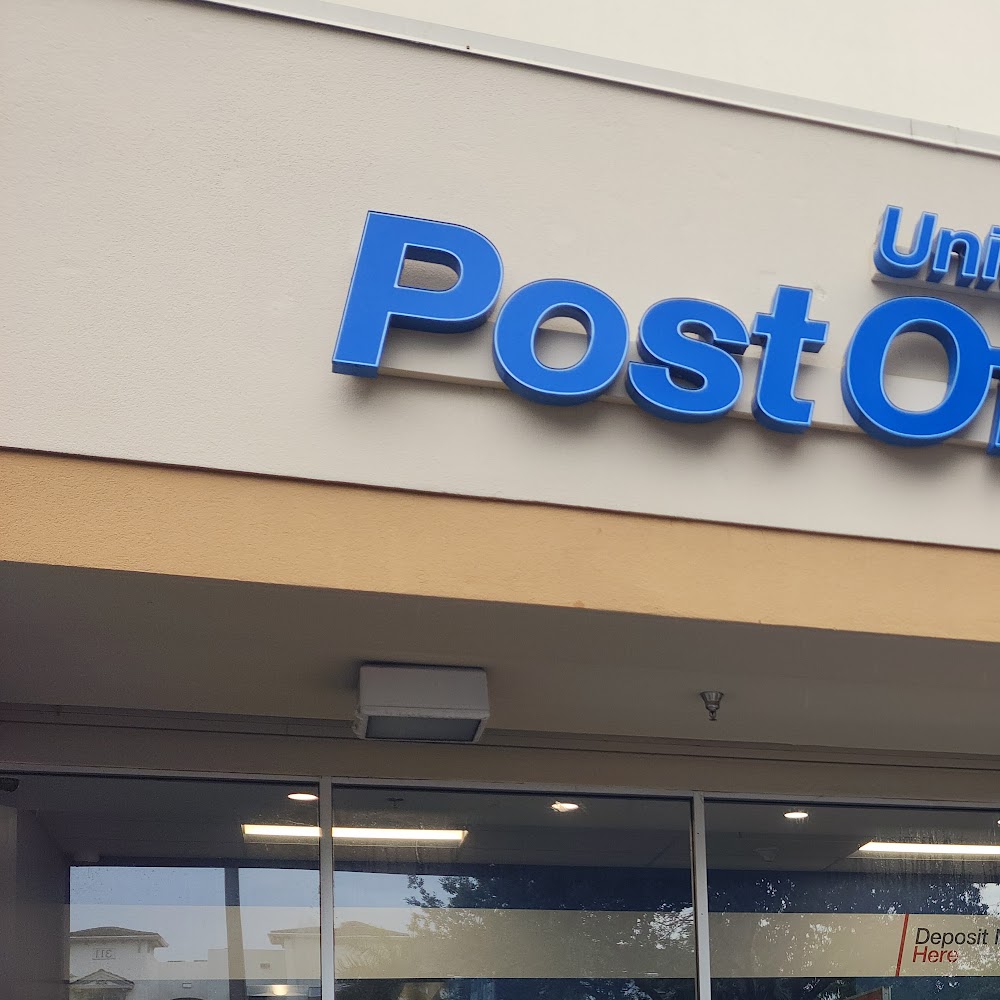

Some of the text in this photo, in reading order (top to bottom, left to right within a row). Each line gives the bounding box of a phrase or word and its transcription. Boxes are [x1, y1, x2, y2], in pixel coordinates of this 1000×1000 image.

[333, 211, 829, 433] Post
[915, 927, 989, 949] Deposit
[912, 946, 959, 963] Here
